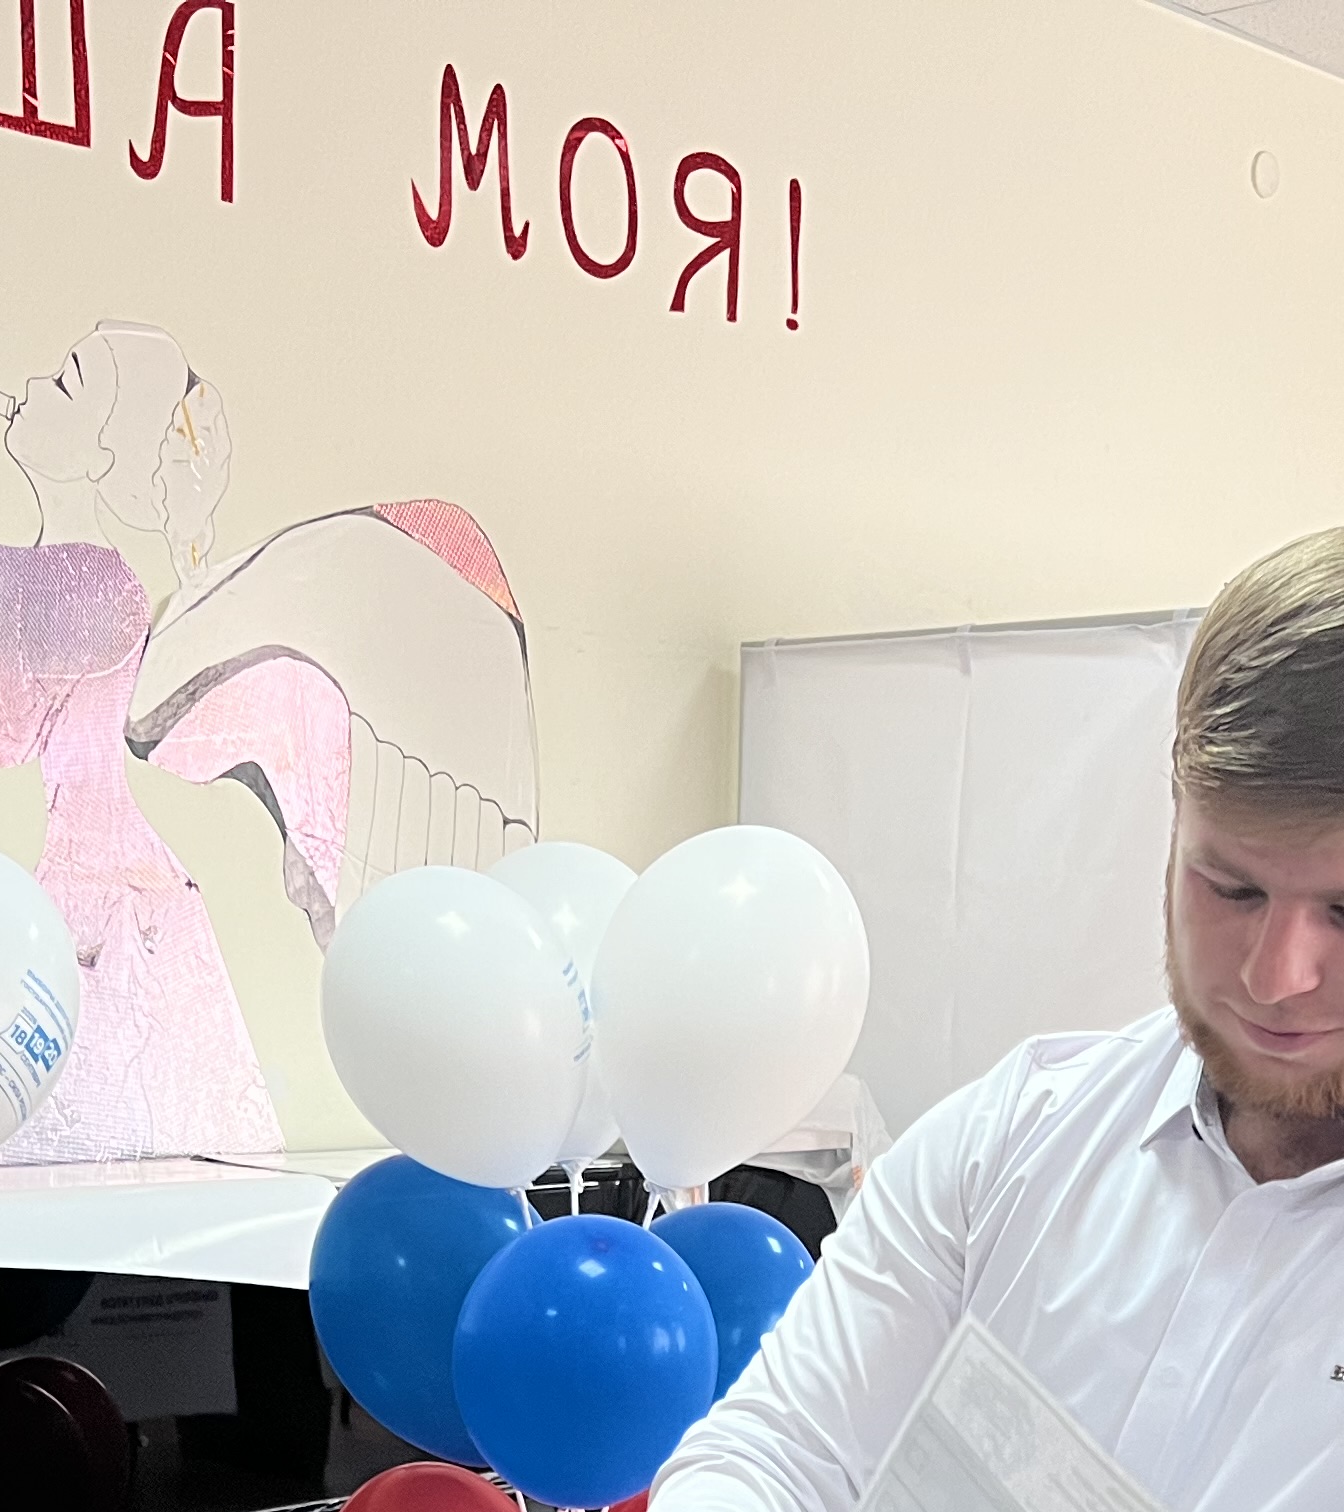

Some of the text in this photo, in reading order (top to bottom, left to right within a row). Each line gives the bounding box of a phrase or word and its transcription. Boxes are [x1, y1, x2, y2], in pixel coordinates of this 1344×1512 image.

[411, 64, 802, 331] МОЯ!
[10, 1024, 28, 1046] 18
[31, 1031, 45, 1055] 19
